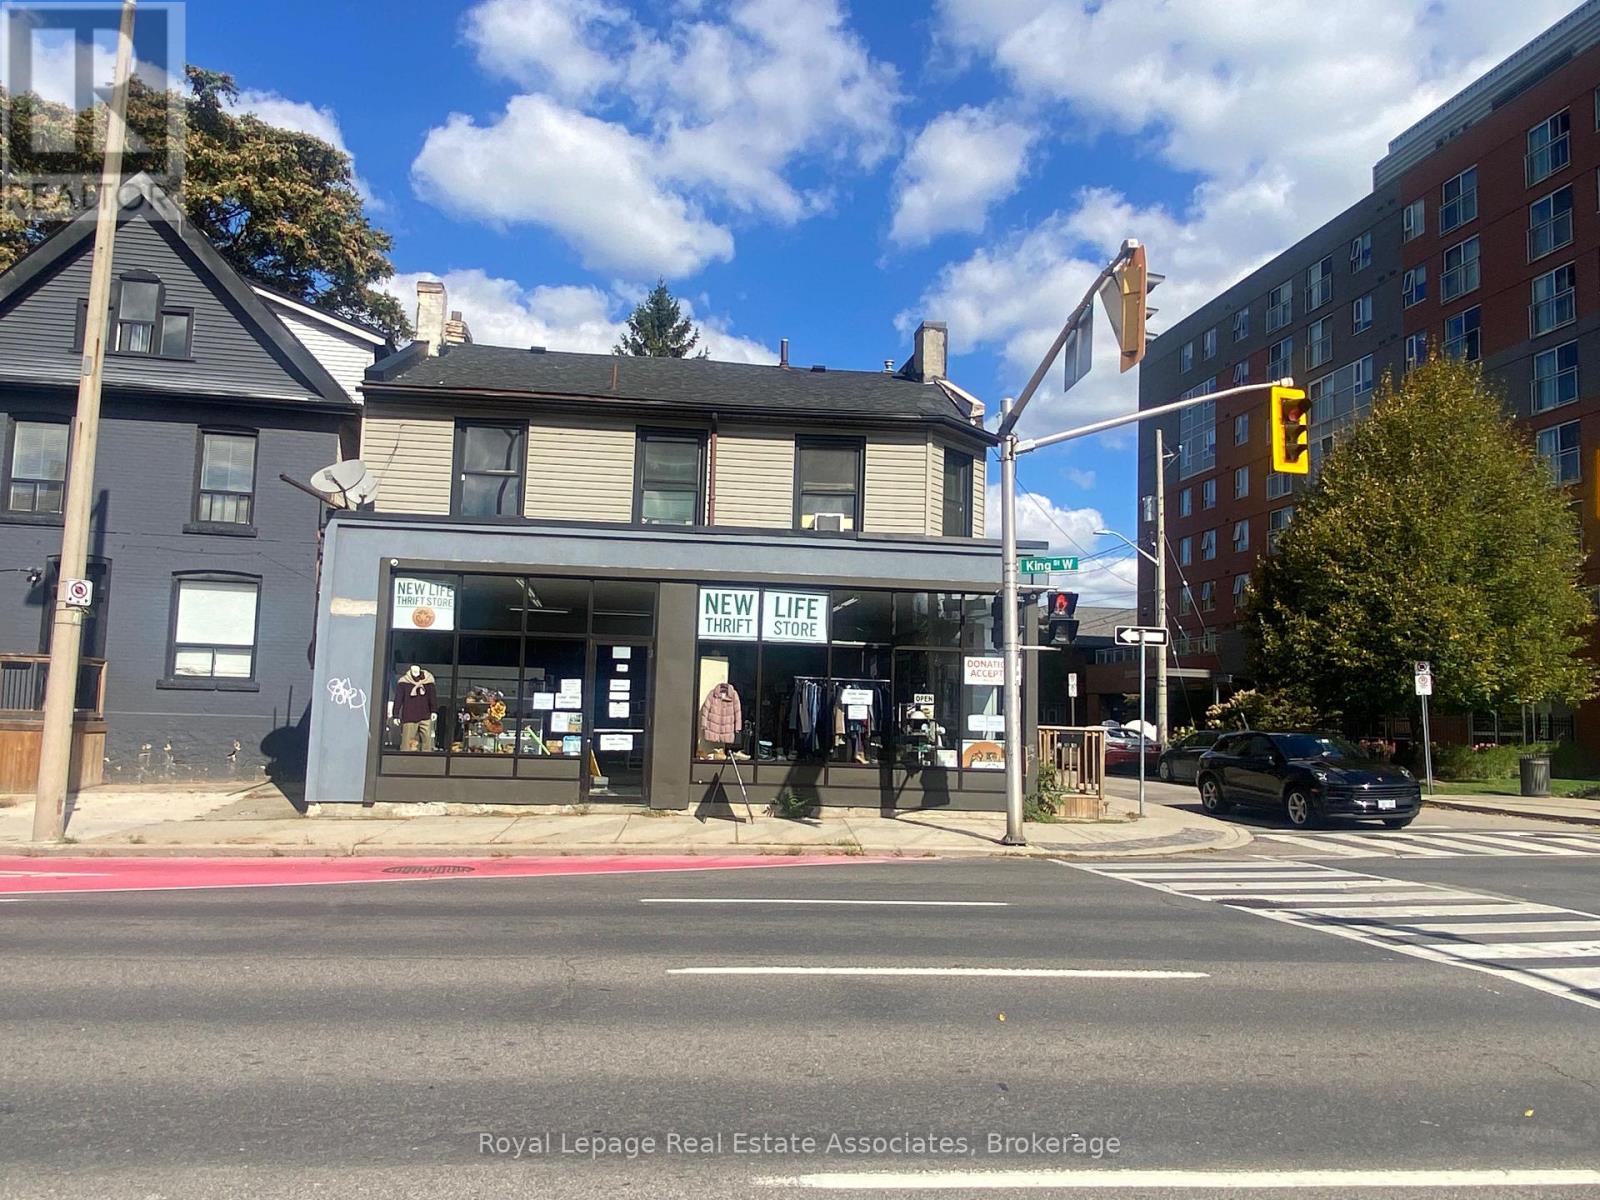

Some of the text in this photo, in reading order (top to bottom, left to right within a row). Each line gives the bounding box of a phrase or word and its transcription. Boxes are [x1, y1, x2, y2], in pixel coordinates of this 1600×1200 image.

[1026, 560, 1052, 573] King
[1062, 559, 1073, 570] W
[397, 581, 454, 598] NEW LIFE
[397, 595, 453, 608] THRIFT STORE
[705, 592, 819, 620] NEW LIFE
[705, 617, 818, 637] THRIFT STORE
[970, 669, 1004, 678] ACCEPT
[915, 695, 933, 703] OPEN
